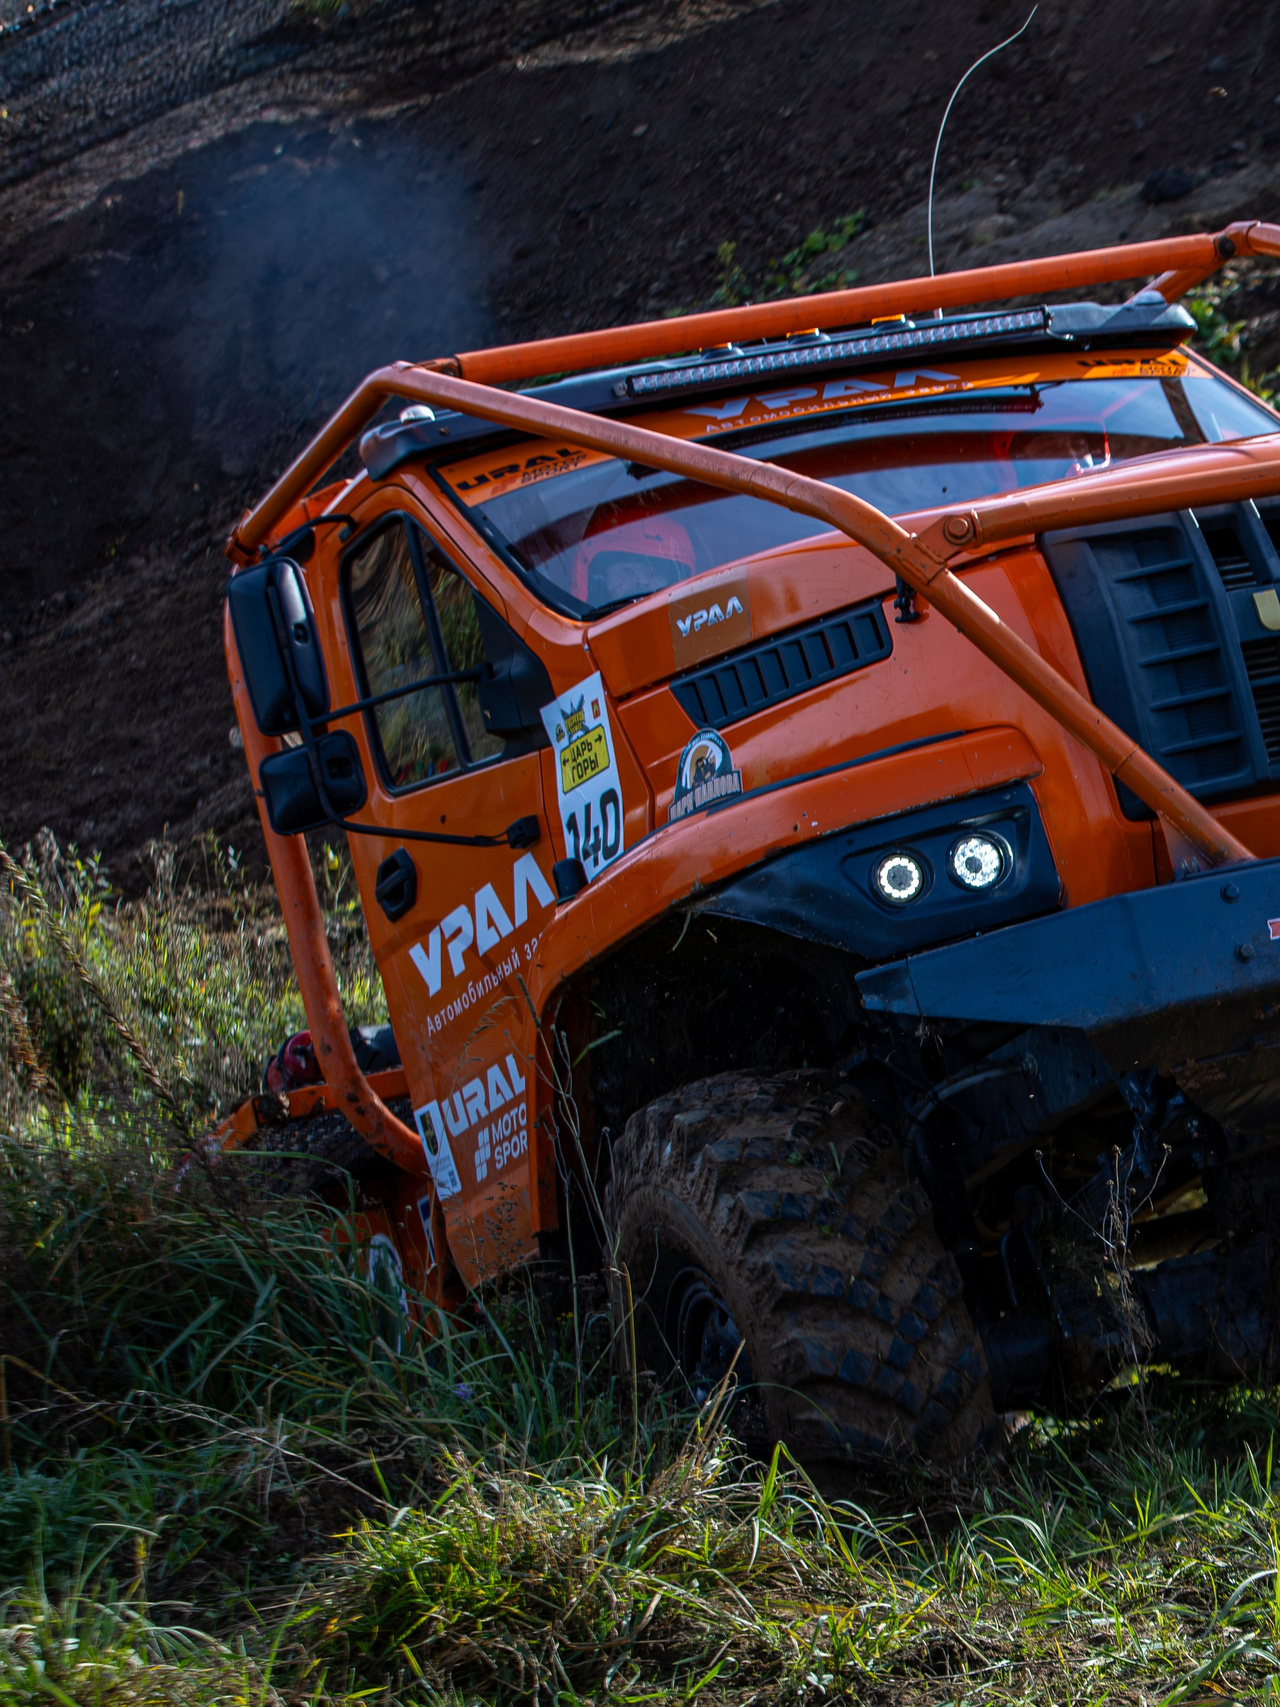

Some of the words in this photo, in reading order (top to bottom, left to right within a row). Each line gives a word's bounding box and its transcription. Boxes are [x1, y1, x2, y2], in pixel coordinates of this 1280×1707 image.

[682, 369, 961, 420] УРАЛ
[456, 448, 583, 490] URAL
[676, 596, 743, 637] УРАЛ
[571, 739, 593, 763] ЦАРЬ
[571, 752, 599, 783] ГОРЫ
[566, 788, 620, 868] 140
[408, 851, 555, 998] УРАЛ
[426, 947, 521, 1037] Автомобильный
[441, 1053, 526, 1138] URAL
